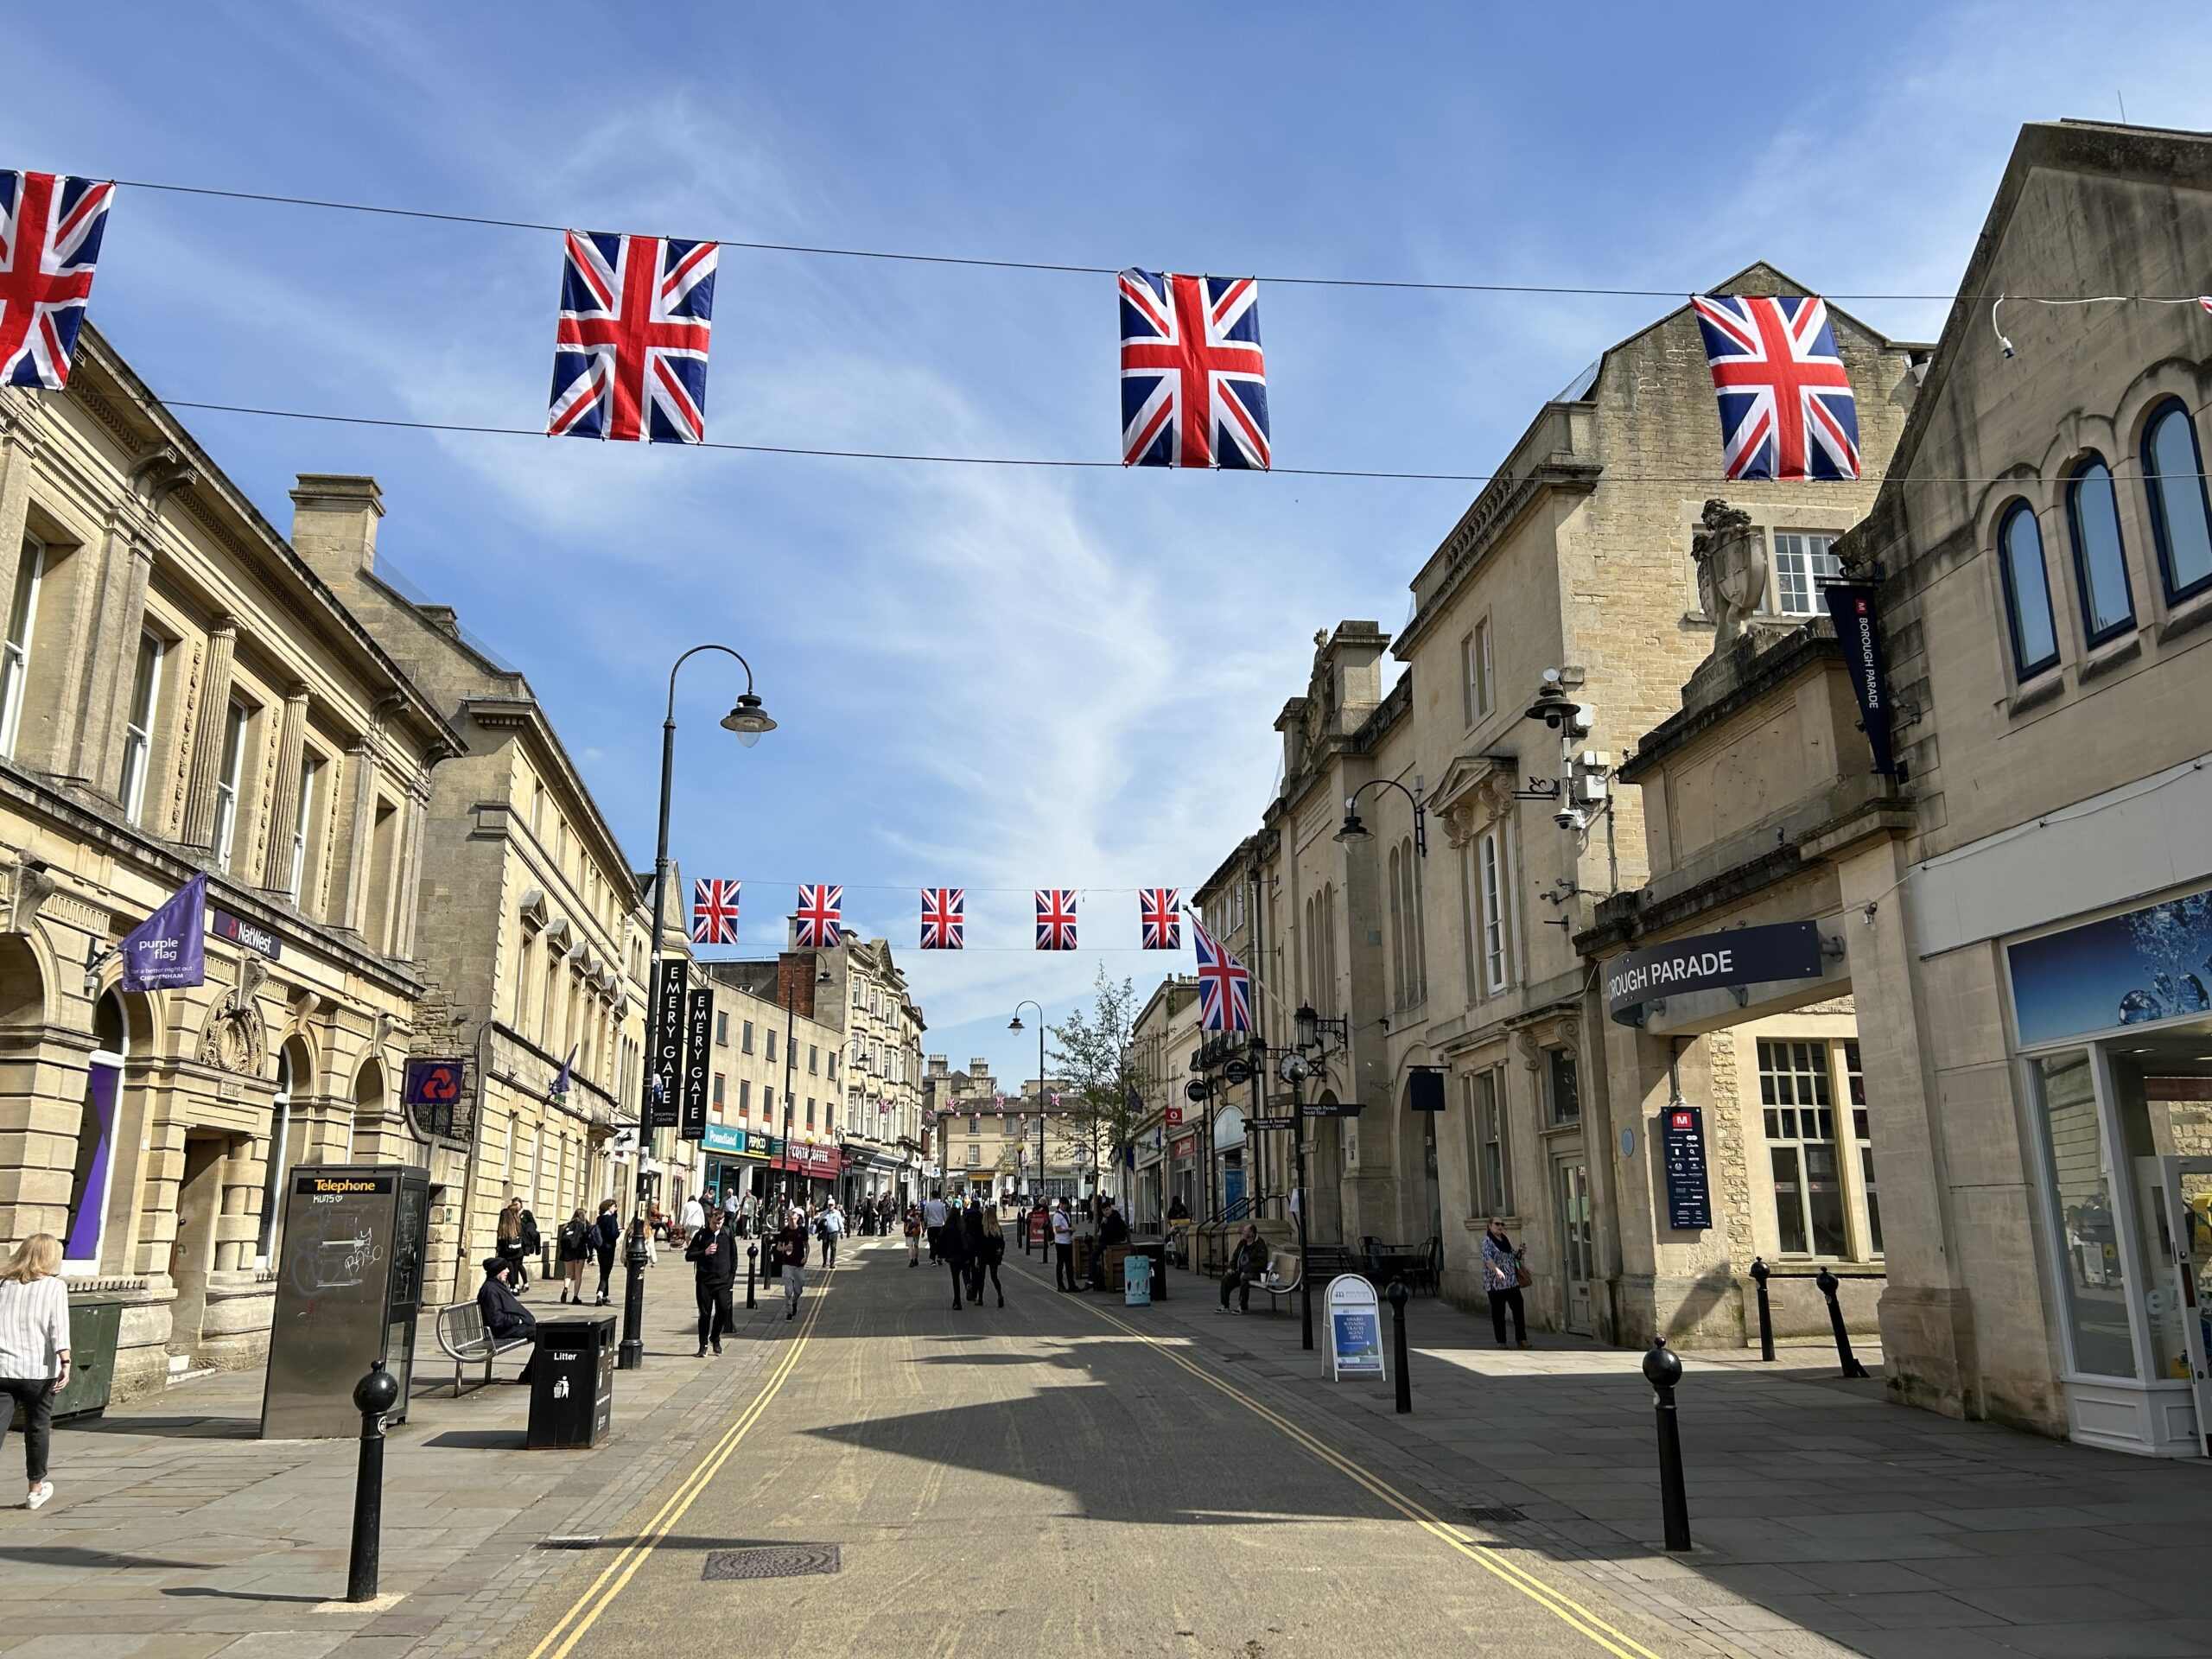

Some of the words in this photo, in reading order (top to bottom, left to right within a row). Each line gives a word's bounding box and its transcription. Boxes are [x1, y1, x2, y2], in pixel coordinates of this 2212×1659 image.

[1859, 617, 1874, 666] BOROUGH
[1866, 669, 1878, 709] PARADE
[139, 938, 178, 951] purple
[154, 949, 177, 961] flag
[238, 922, 271, 953] NatWest
[1608, 966, 1648, 1001] OROUGH
[1650, 950, 1733, 985] PARADE
[665, 967, 680, 1039] EMERY
[694, 995, 707, 1060] EMERY
[662, 1046, 676, 1104] GATE
[690, 1066, 703, 1119] GATE
[709, 1129, 738, 1147] Poundland
[791, 1145, 810, 1160] COSTA
[314, 1179, 376, 1193] Telephone
[554, 1351, 577, 1361] Litter
